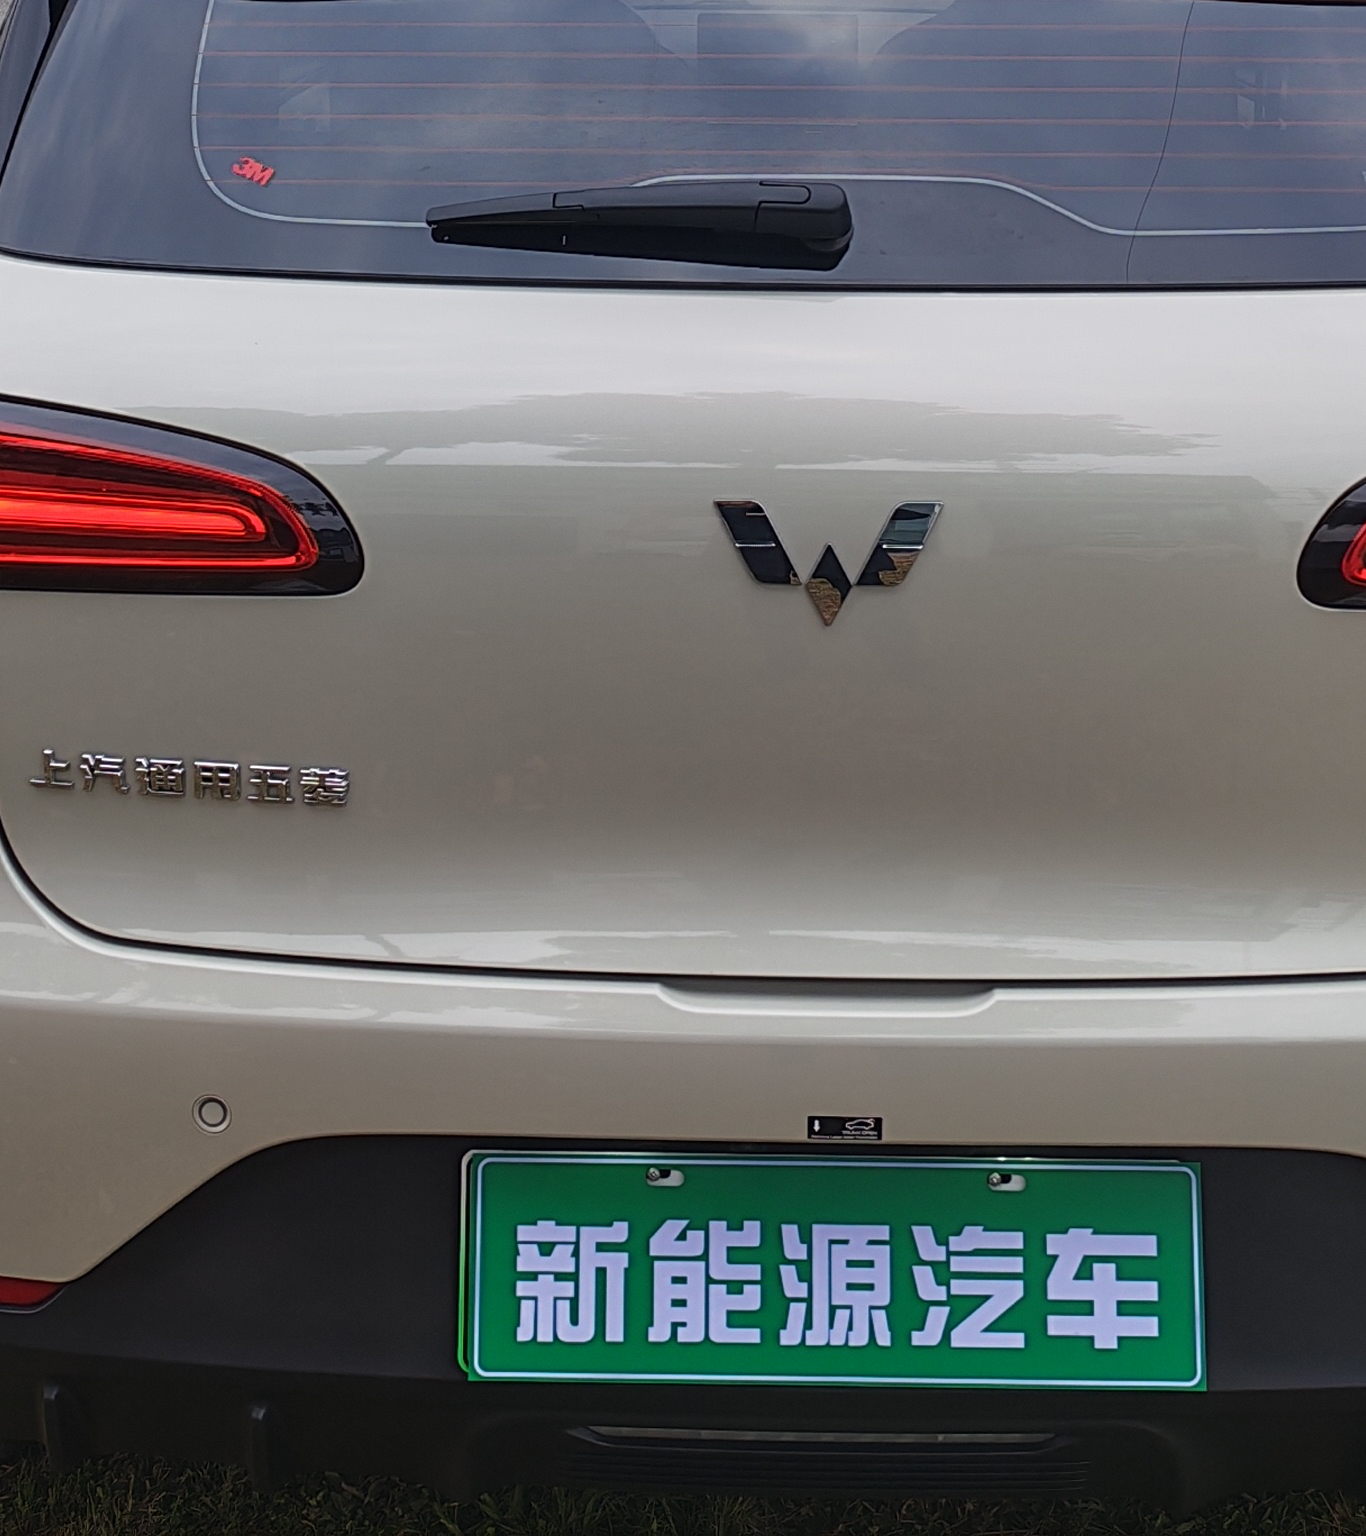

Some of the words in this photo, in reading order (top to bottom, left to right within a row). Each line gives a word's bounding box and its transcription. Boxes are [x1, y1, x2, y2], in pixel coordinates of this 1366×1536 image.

[232, 156, 275, 187] 3M
[29, 748, 351, 807] 上汽通用五菱
[516, 1219, 1160, 1349] 新能源汽车
